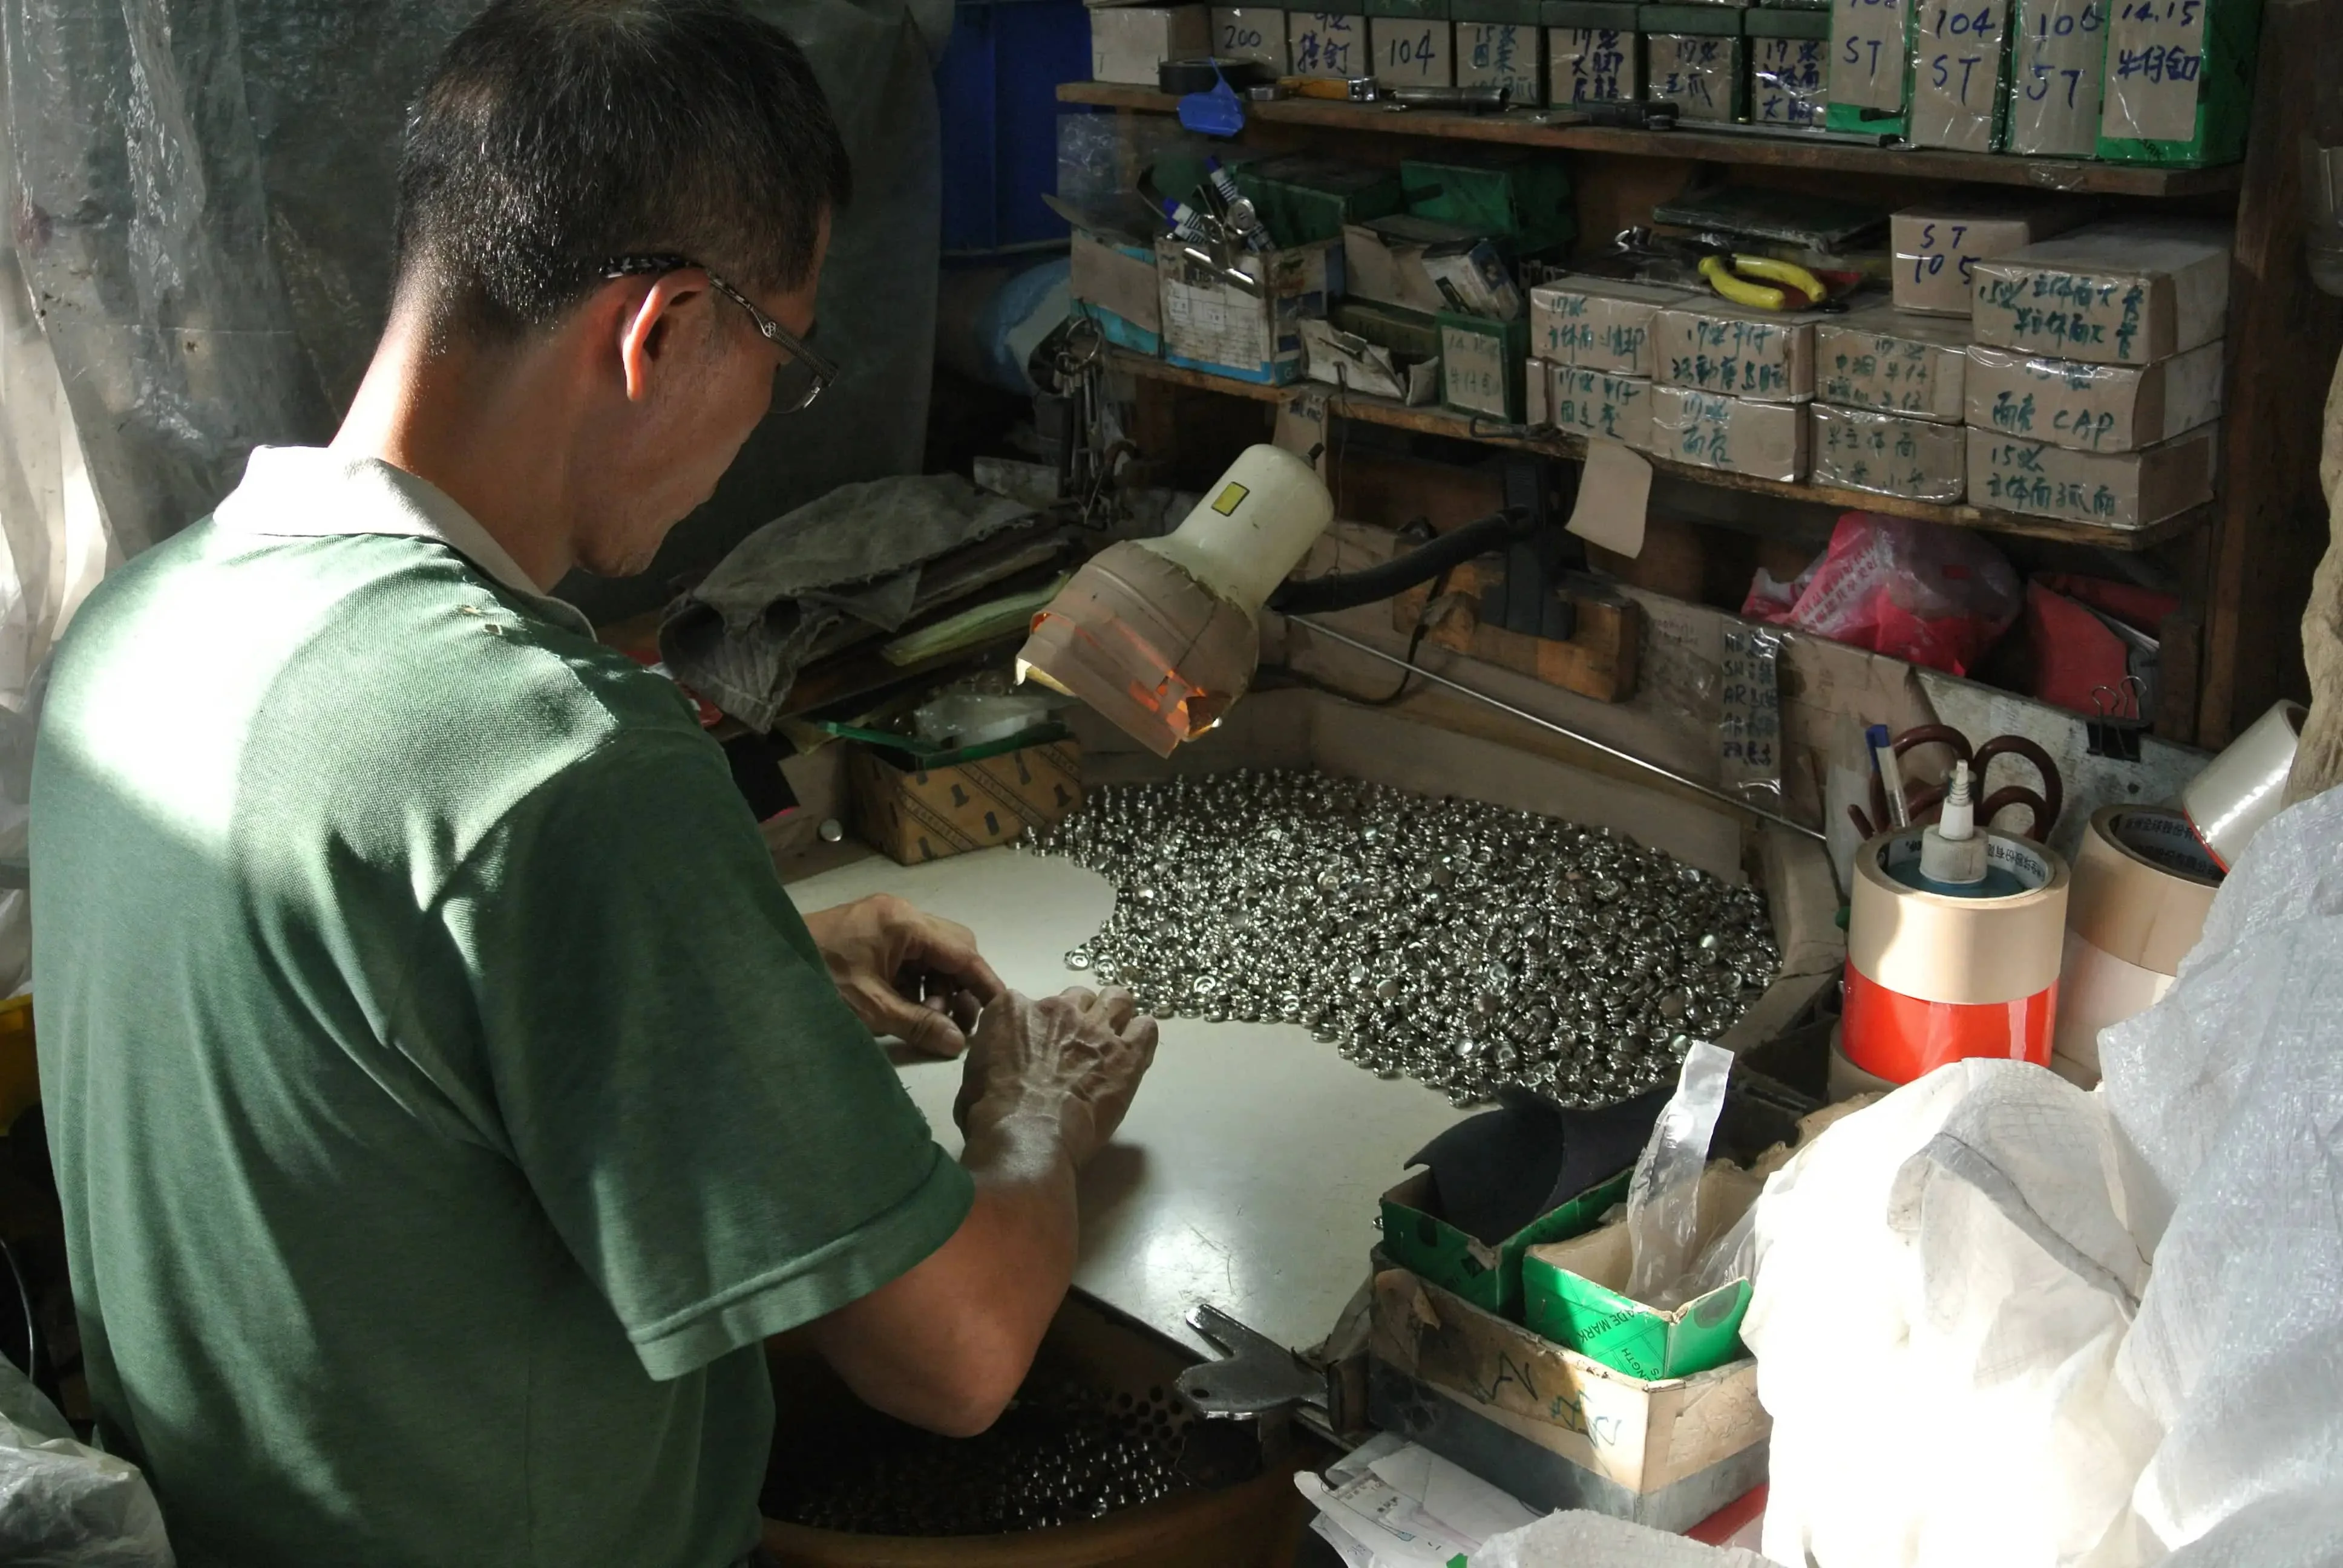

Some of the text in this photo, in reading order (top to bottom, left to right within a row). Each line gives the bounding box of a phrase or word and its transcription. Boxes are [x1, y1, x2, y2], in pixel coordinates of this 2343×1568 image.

[1224, 26, 1262, 50] 200
[1935, 7, 1996, 39] 104
[1391, 29, 1436, 75] 104
[1843, 36, 1883, 76] ST
[1932, 54, 1981, 106] ST
[1919, 223, 1968, 249] ST
[1915, 253, 1982, 284] 105
[2053, 409, 2114, 450] CAP
[1577, 1318, 1612, 1345] MARK
